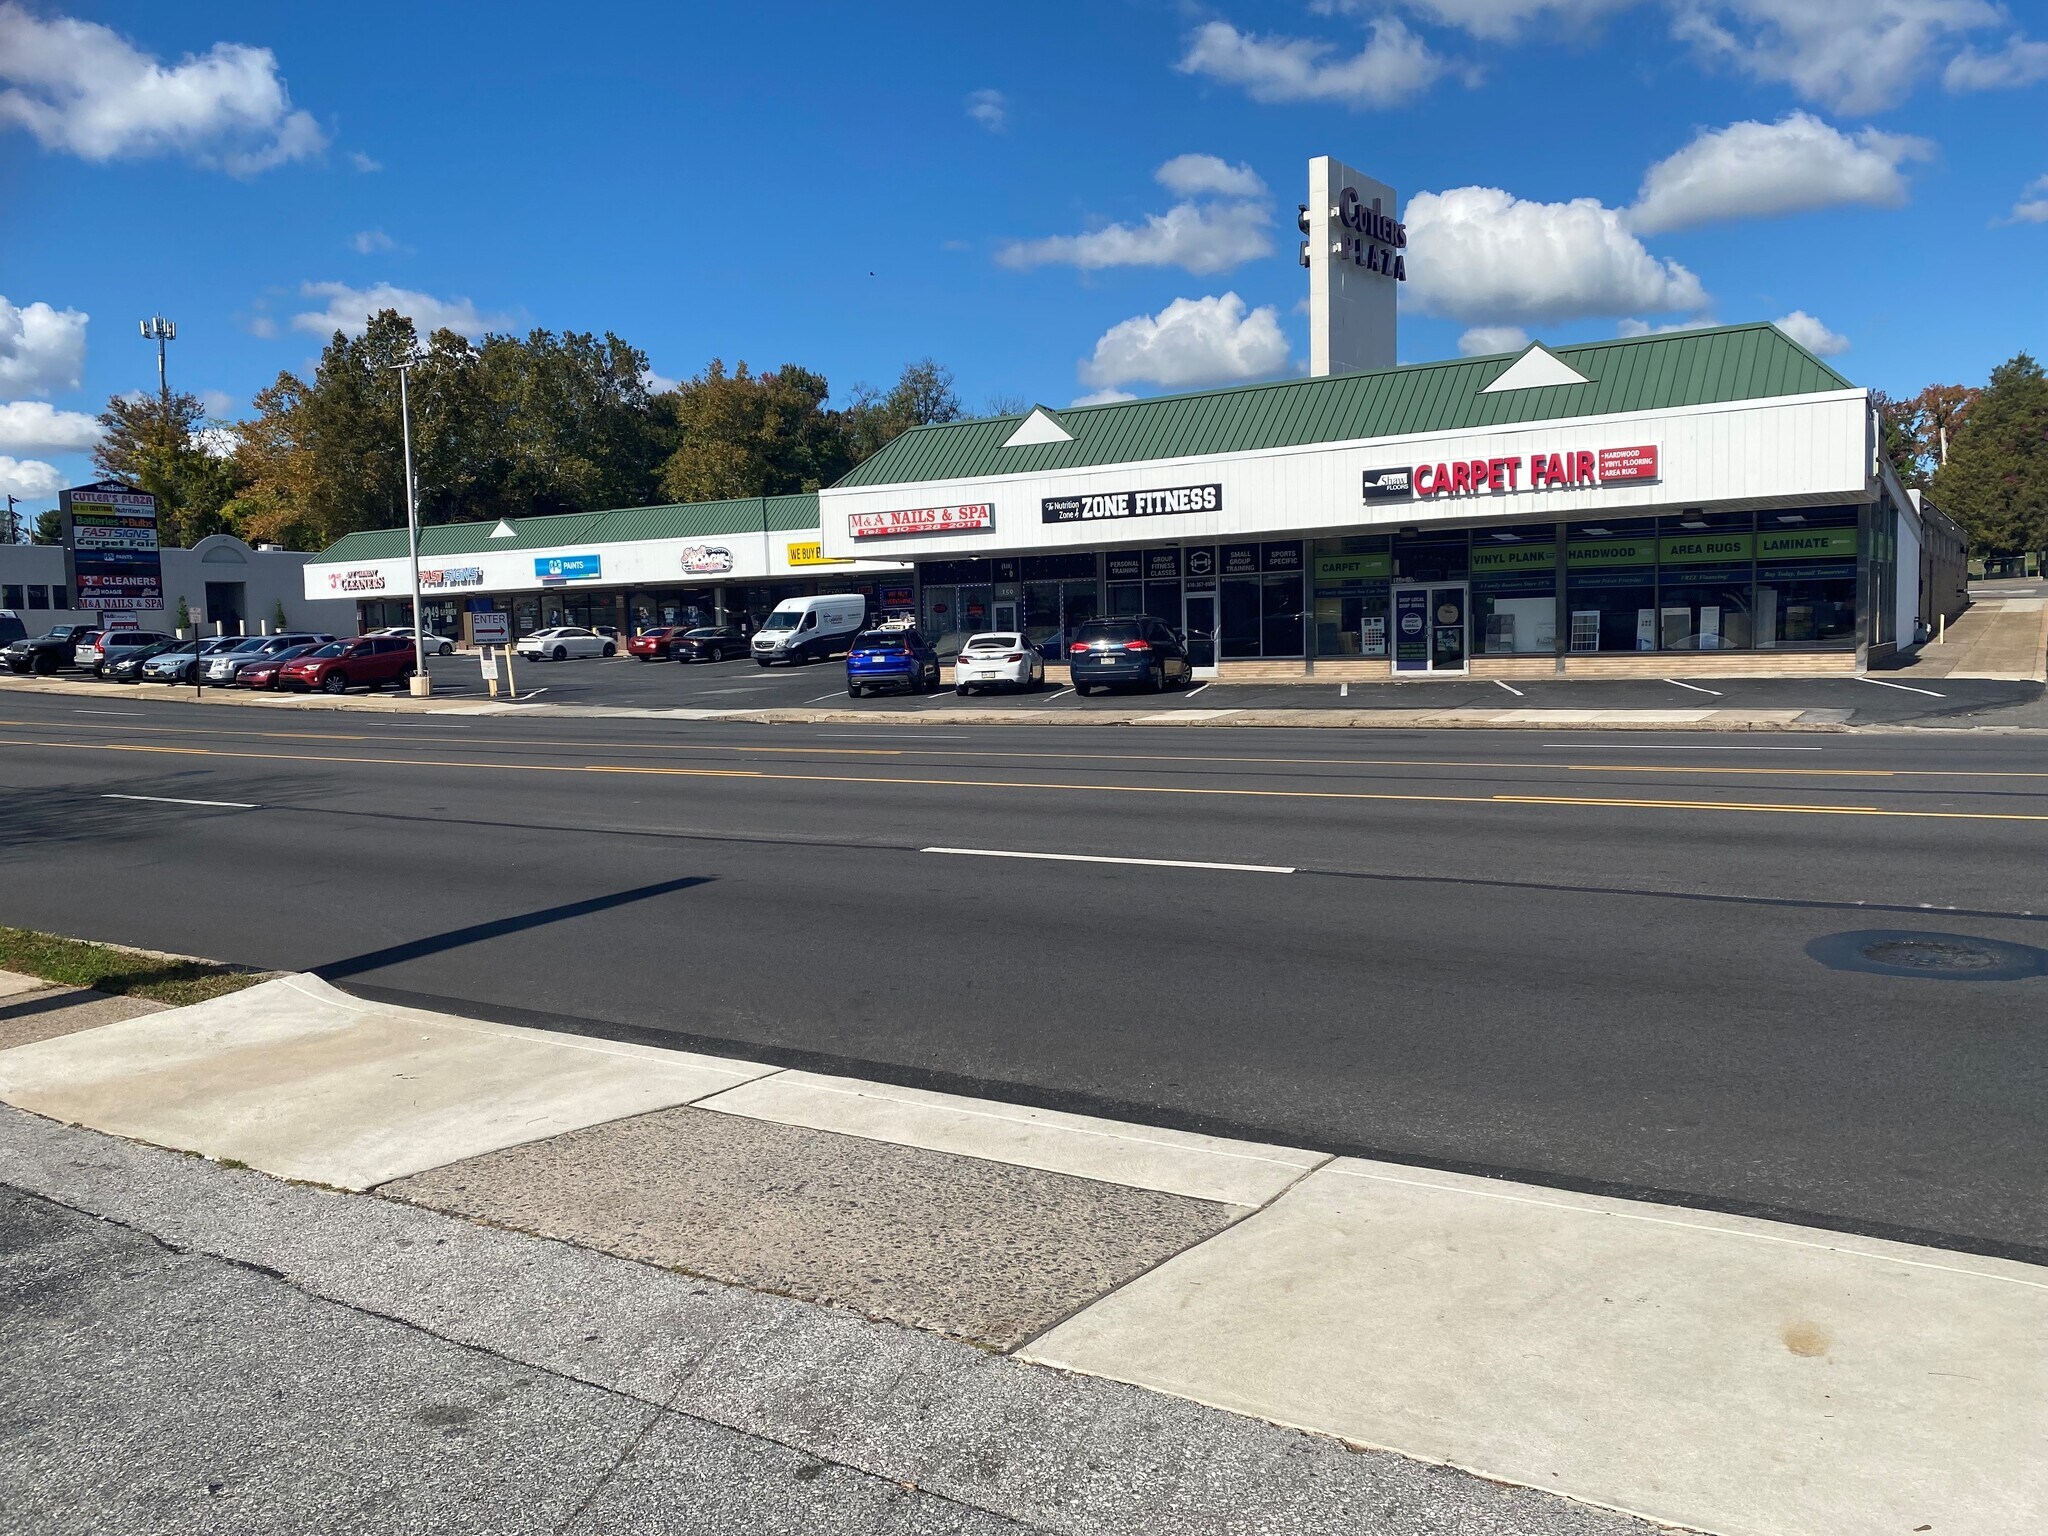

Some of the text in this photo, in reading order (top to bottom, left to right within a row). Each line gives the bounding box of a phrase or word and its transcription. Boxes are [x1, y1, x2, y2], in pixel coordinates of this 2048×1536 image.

[1340, 233, 1406, 281] PLAZA
[1604, 450, 1640, 458] HARDWOOD
[1604, 458, 1653, 468] VINYL FLOORING
[1414, 450, 1595, 495] CARPET FAIR
[1604, 468, 1638, 477] AREA RUGS
[1381, 474, 1407, 486] Shaw
[1386, 483, 1409, 491] FLOORS
[72, 492, 153, 505] CUTLER'S PLAZA
[1082, 487, 1216, 518] ZONE FITNESS
[1054, 501, 1080, 510] Nutrition
[891, 509, 935, 525] NAILS
[942, 508, 953, 521] &
[959, 505, 989, 520] SPA
[1059, 511, 1074, 519] Zone
[76, 516, 119, 526] Batteries
[128, 519, 154, 528] Bulbs
[887, 521, 978, 533] 610-328-2011
[82, 528, 150, 538] FASTSIGNS
[76, 539, 156, 548] Carpet Fair
[1670, 542, 1741, 555] AREA RUGS
[1763, 537, 1829, 551] LAMINATE
[790, 548, 801, 560] WE
[802, 547, 815, 560] BUY
[1473, 554, 1506, 565] VINYL
[1509, 551, 1546, 562] PLANK
[1568, 548, 1636, 559] HARDWOOD
[563, 561, 584, 570] PAINTS
[1322, 562, 1361, 572] CARPET
[102, 577, 156, 586] CLEANERS
[342, 577, 385, 591] CLEANERS
[79, 599, 163, 609] M&A NAILS & SPA
[473, 614, 506, 624] ENTER
